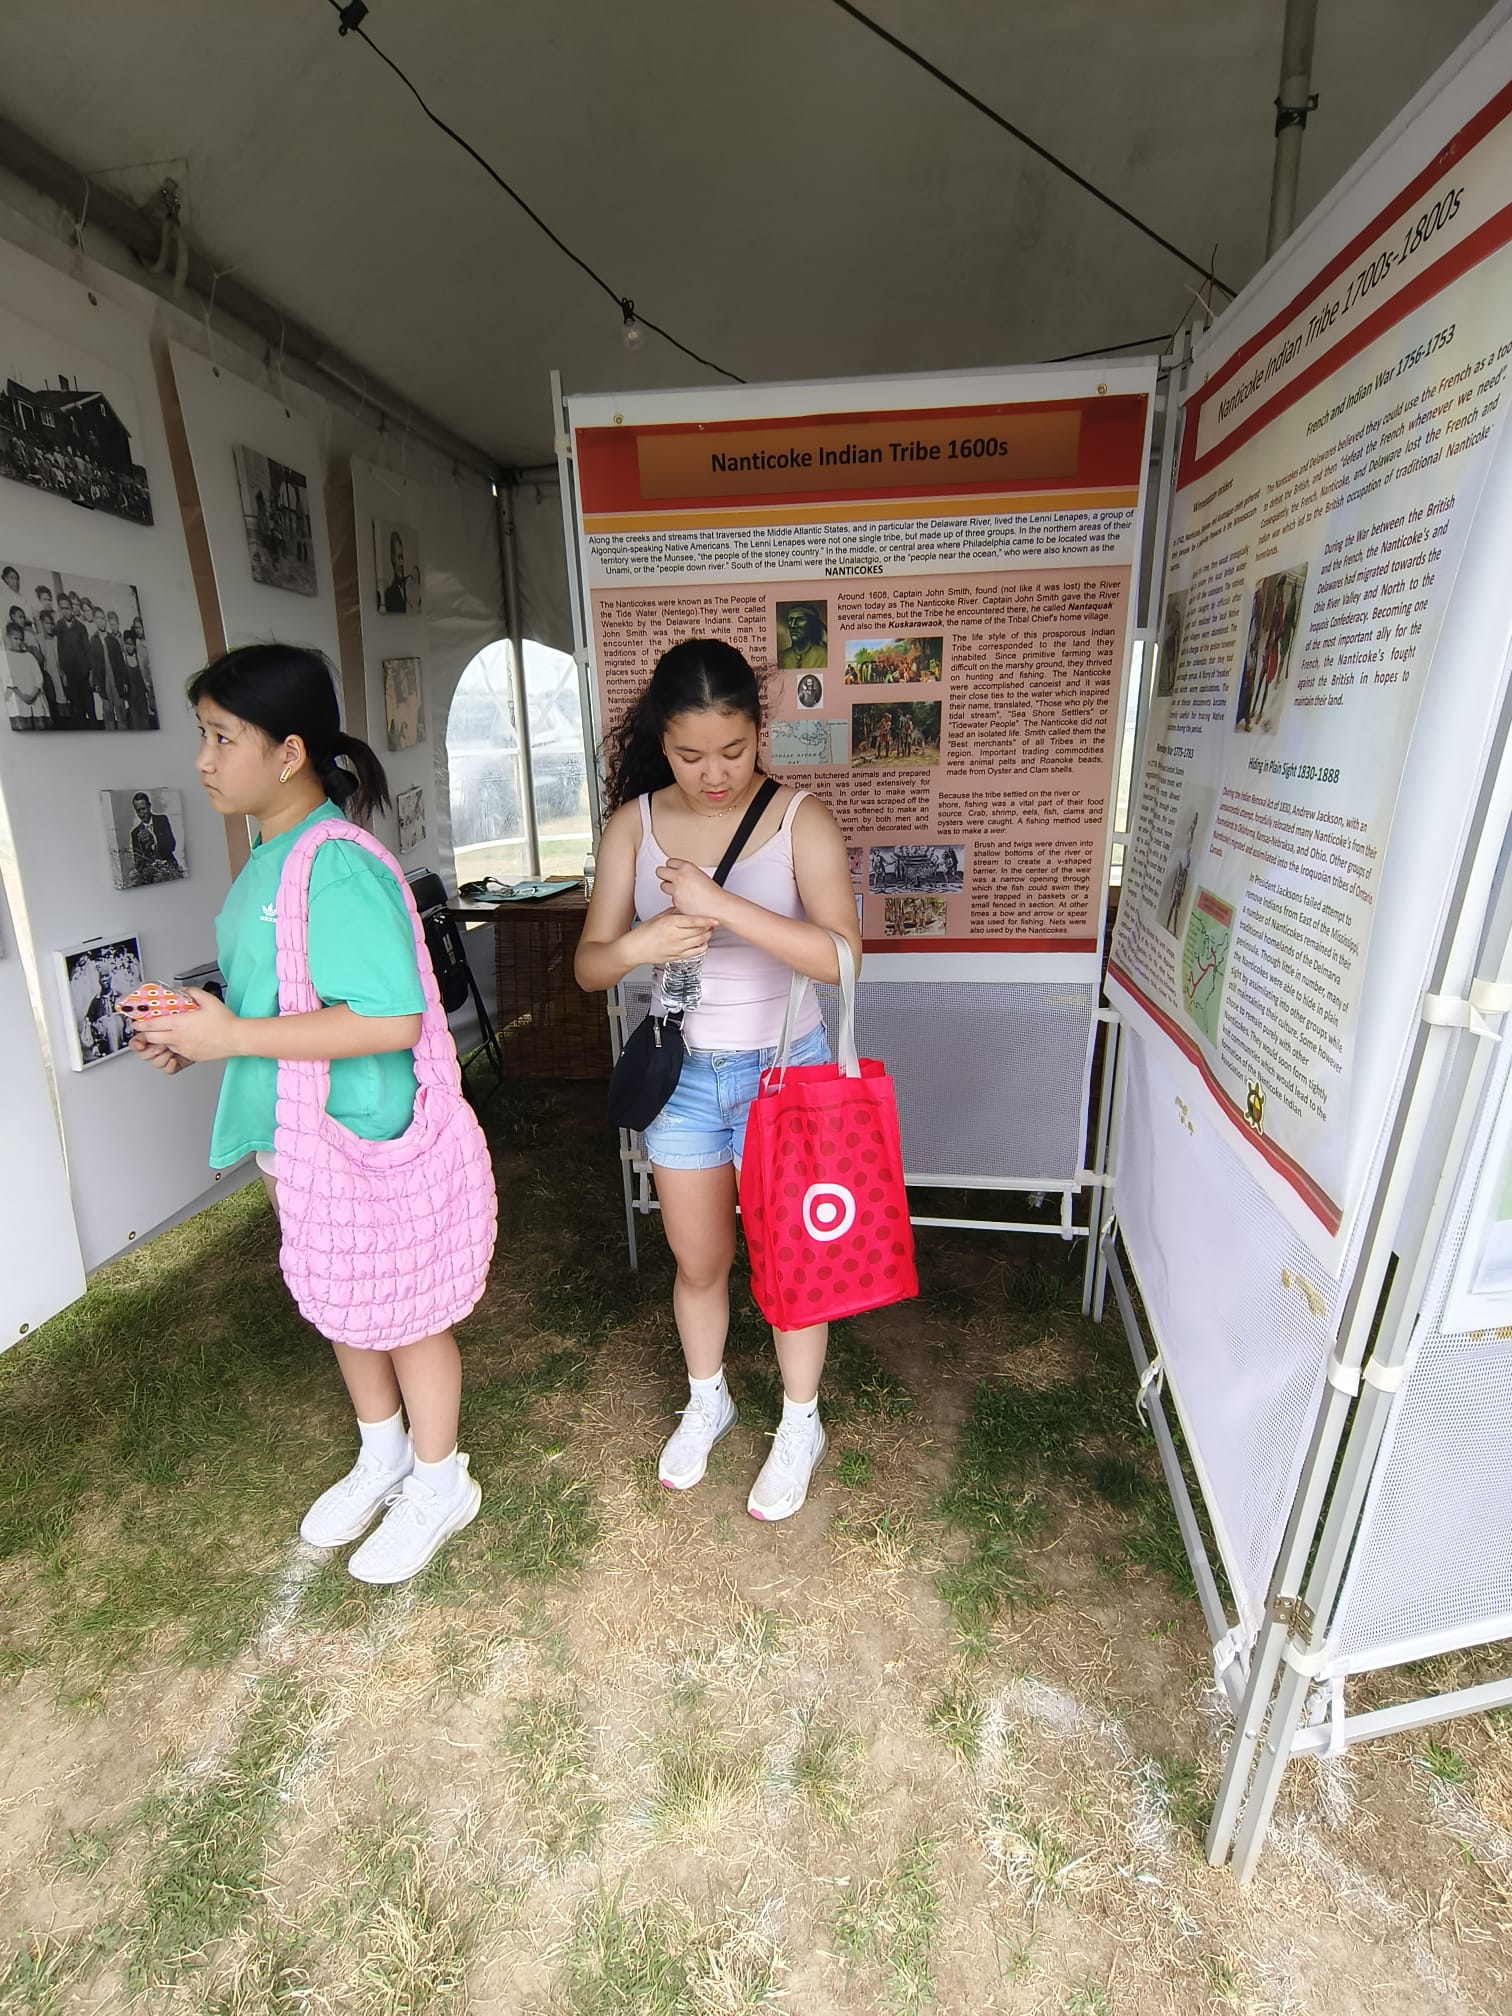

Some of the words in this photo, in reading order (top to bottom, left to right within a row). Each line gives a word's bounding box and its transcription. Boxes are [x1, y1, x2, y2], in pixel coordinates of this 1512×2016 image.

[1218, 368, 1264, 423] Nanticoke
[1264, 335, 1303, 383] Indian
[1306, 300, 1340, 347] Tribe
[1342, 187, 1464, 315] 1700s-1800s
[1306, 411, 1329, 436] French
[1330, 400, 1345, 420] and
[1346, 383, 1372, 410] Indian
[1374, 369, 1395, 391] War
[1396, 324, 1455, 377] 1756-1753
[712, 448, 812, 472] Nanticoke
[819, 444, 882, 466] Indian
[889, 441, 941, 462] Tribe
[948, 437, 1008, 459] 1600s
[588, 535, 610, 546] Along
[611, 534, 623, 543] the
[625, 533, 650, 542] creeks
[651, 532, 666, 541] and
[668, 531, 697, 540] streams
[699, 530, 714, 539] that
[715, 528, 751, 538] traversed
[752, 528, 765, 536] the
[766, 526, 792, 536] Middle
[793, 525, 822, 535] Atlantic
[823, 523, 850, 535] States,
[852, 523, 867, 532] and
[868, 522, 876, 531] in
[877, 520, 914, 532] particular
[916, 519, 928, 528] the
[930, 517, 967, 528] Delaware
[969, 516, 991, 527] River,
[994, 515, 1013, 524] lived
[1014, 514, 1027, 523] the
[1029, 513, 1051, 522] Lenni
[1053, 511, 1091, 523] Lenapes,
[1099, 511, 1123, 520] group
[1125, 508, 1134, 517] of
[1324, 538, 1344, 556] During
[1343, 533, 1355, 547] the
[1355, 527, 1370, 542] War
[1370, 515, 1405, 536] between
[1407, 507, 1423, 524] the
[1426, 494, 1456, 517] British
[824, 567, 883, 577] NANTICOKES
[837, 591, 865, 600] Around
[892, 588, 922, 599] Captain
[925, 587, 944, 596] John
[947, 586, 972, 597] Smith,
[975, 585, 997, 594] found
[1000, 584, 1016, 594] (not
[1019, 583, 1032, 592] like
[1035, 583, 1040, 591] it
[1063, 581, 1080, 591] lost)
[1083, 580, 1096, 589] the
[1099, 579, 1120, 588] River
[599, 600, 613, 608] The
[615, 598, 655, 608] Nanticokes
[677, 596, 701, 605] known
[715, 595, 728, 604] The
[730, 594, 756, 605] People
[758, 594, 765, 602] of
[637, 618, 646, 628] by
[650, 618, 661, 626] the
[665, 616, 700, 625] Delaware
[737, 614, 766, 624] Captain
[839, 622, 855, 630] And
[856, 621, 872, 630] also
[874, 620, 886, 629] the
[946, 617, 959, 626] the
[984, 616, 992, 624] of
[993, 615, 1005, 624] the
[1009, 614, 1029, 623] Tribal
[1059, 612, 1081, 621] home
[952, 632, 966, 641] The
[971, 632, 983, 640] life
[988, 631, 1006, 641] style
[1010, 630, 1019, 639] of
[1023, 630, 1037, 638] this
[1091, 627, 1115, 636] Indian
[1318, 675, 1327, 686] the
[1331, 672, 1355, 685] British
[1359, 671, 1368, 683] in
[1373, 669, 1398, 685] hopes
[1402, 668, 1409, 681] to
[948, 711, 964, 719] tidal
[1032, 708, 1055, 716] Shore
[770, 771, 783, 780] The
[814, 770, 849, 779] butchered
[852, 769, 879, 778] animals
[882, 769, 895, 777] and
[898, 768, 930, 779] prepared
[946, 767, 967, 775] made
[968, 766, 985, 775] from
[987, 766, 1011, 776] Oyster
[1013, 765, 1027, 773] and
[1029, 765, 1048, 773] Clam
[1263, 760, 1269, 772] in
[1269, 760, 1281, 775] Plain
[1282, 763, 1297, 779] Sight
[1297, 764, 1340, 784] 1830-1888
[974, 840, 995, 848] Brush
[997, 839, 1011, 847] and
[1013, 839, 1032, 849] twigs
[1054, 838, 1077, 846] driven
[1079, 838, 1093, 846] into
[1254, 874, 1276, 892] President
[1276, 883, 1303, 903] Jacksons
[1303, 893, 1321, 911] failed
[1321, 903, 1345, 925] attempt
[1345, 914, 1351, 926] to
[970, 925, 984, 933] also
[986, 925, 1003, 933] used
[1004, 925, 1013, 935] by
[1015, 925, 1026, 933] the
